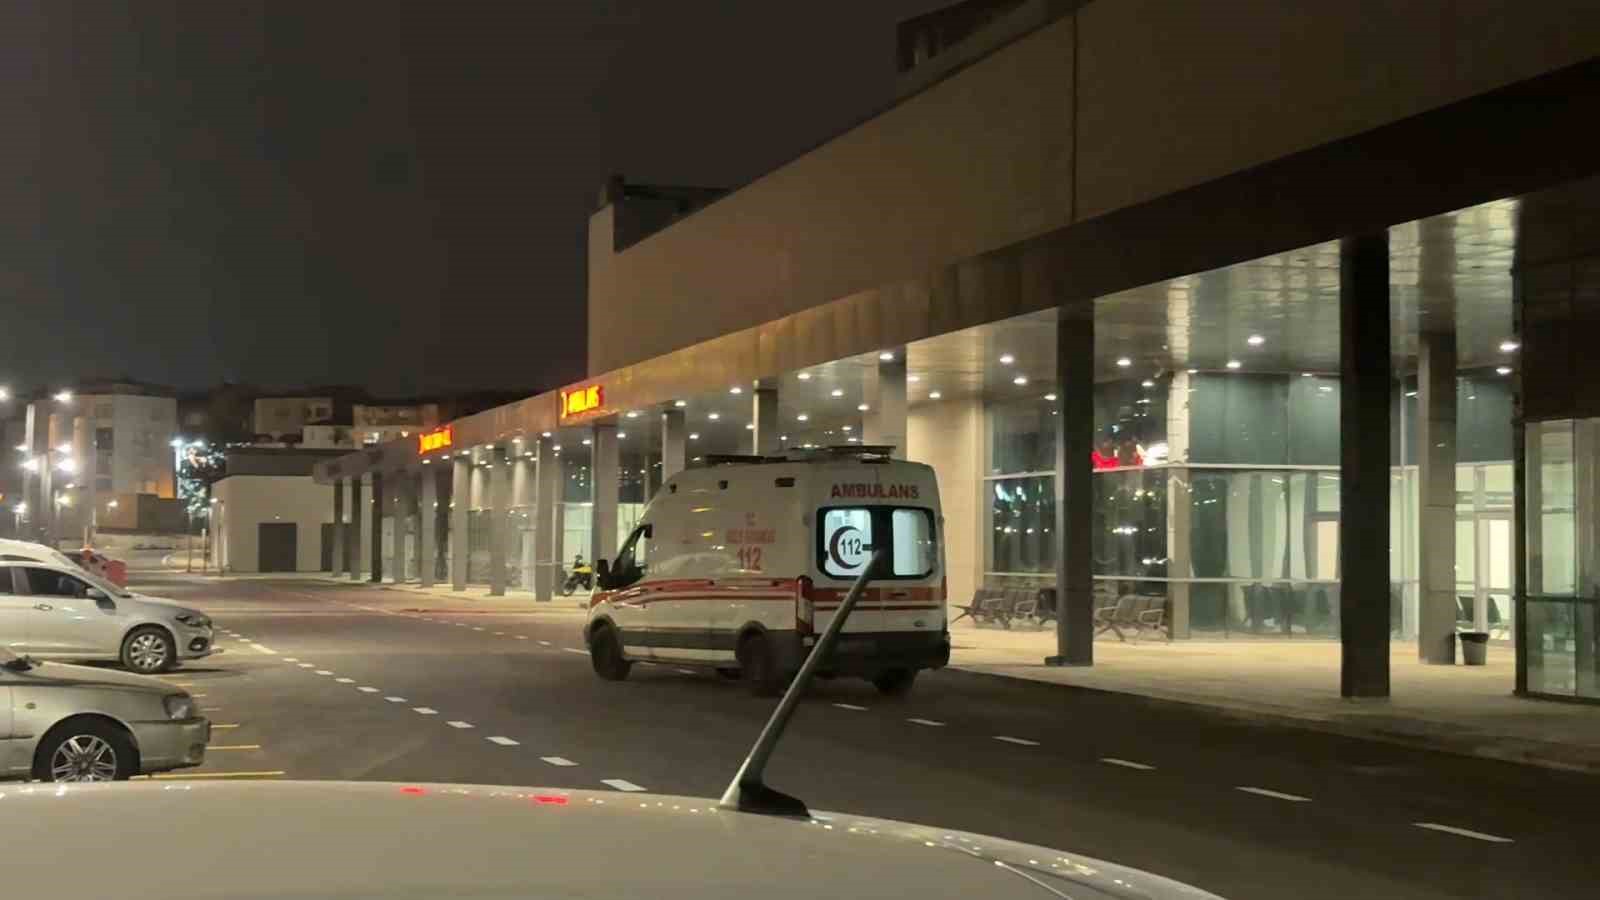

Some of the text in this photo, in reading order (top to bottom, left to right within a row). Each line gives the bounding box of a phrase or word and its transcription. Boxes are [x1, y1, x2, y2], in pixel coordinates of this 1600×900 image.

[831, 483, 920, 499] AMBULANS
[841, 538, 862, 556] 112
[736, 546, 761, 571] 112
